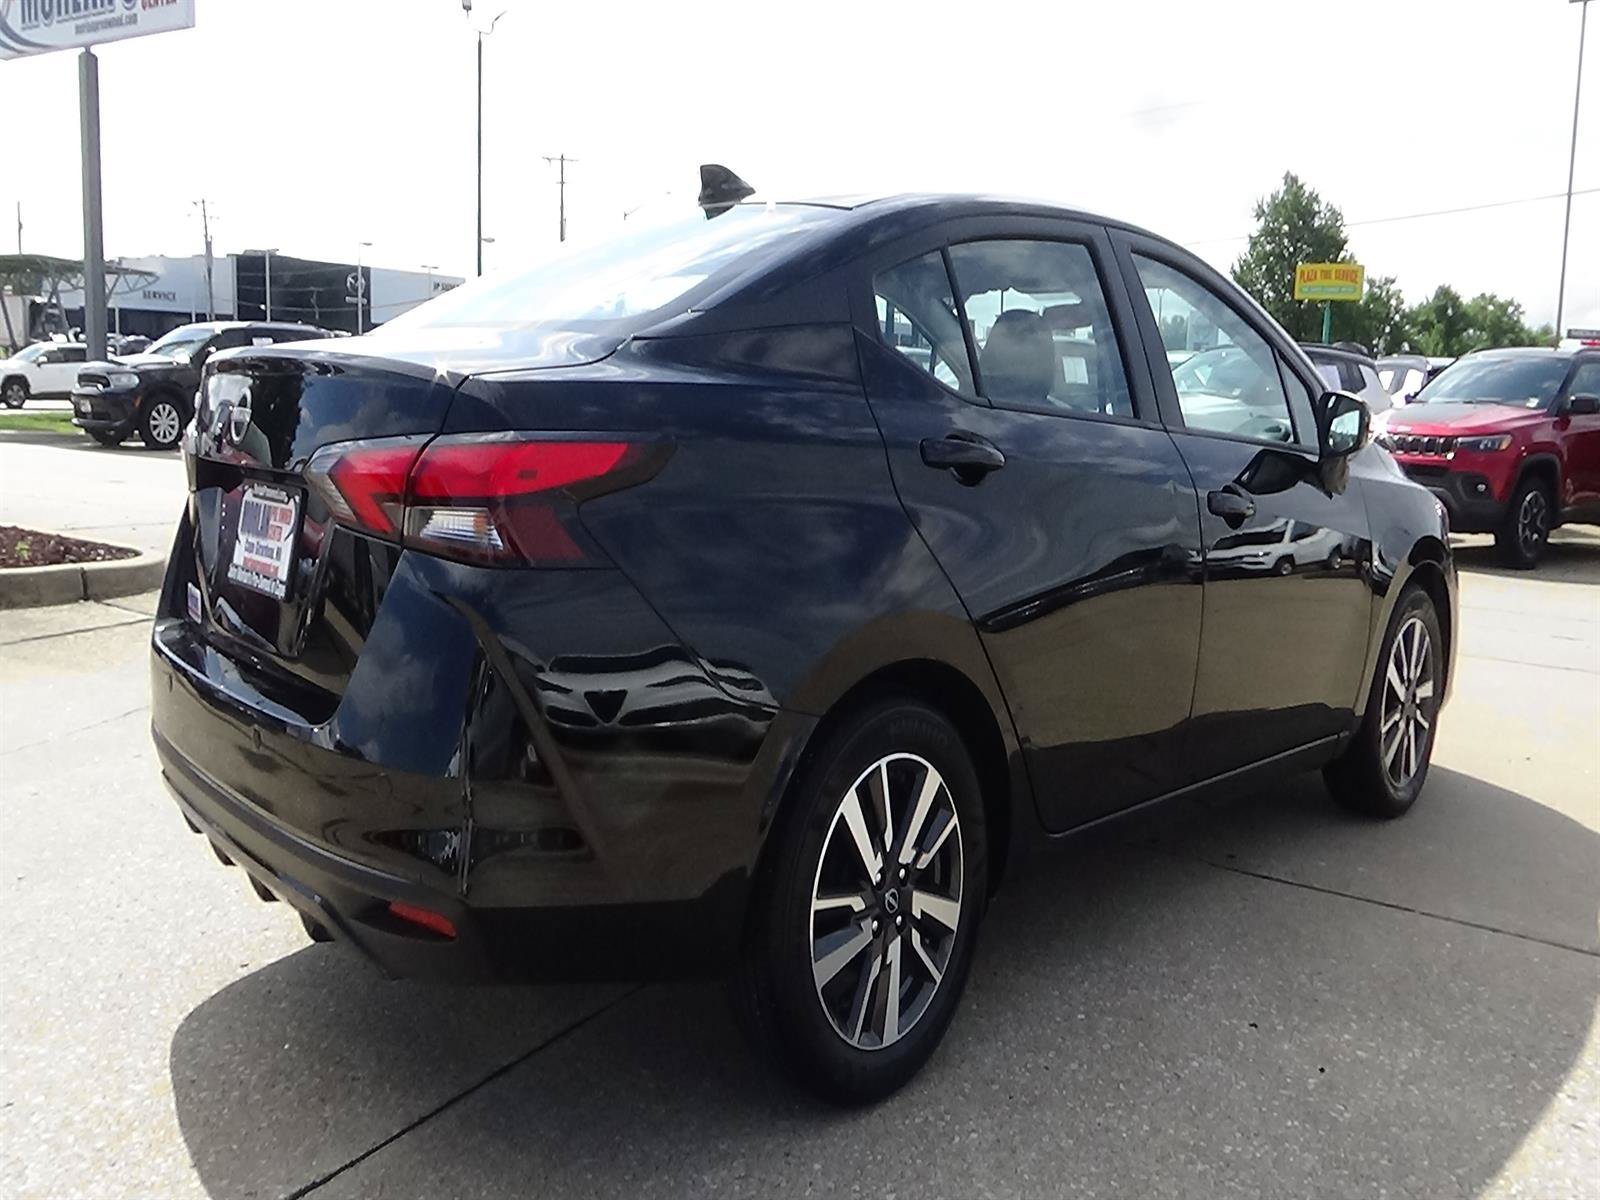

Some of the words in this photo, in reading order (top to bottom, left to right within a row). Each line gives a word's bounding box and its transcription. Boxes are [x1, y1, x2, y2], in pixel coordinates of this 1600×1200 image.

[142, 0, 176, 11] CENT
[20, 0, 115, 28] MOR
[1300, 269, 1318, 283] PLAZA
